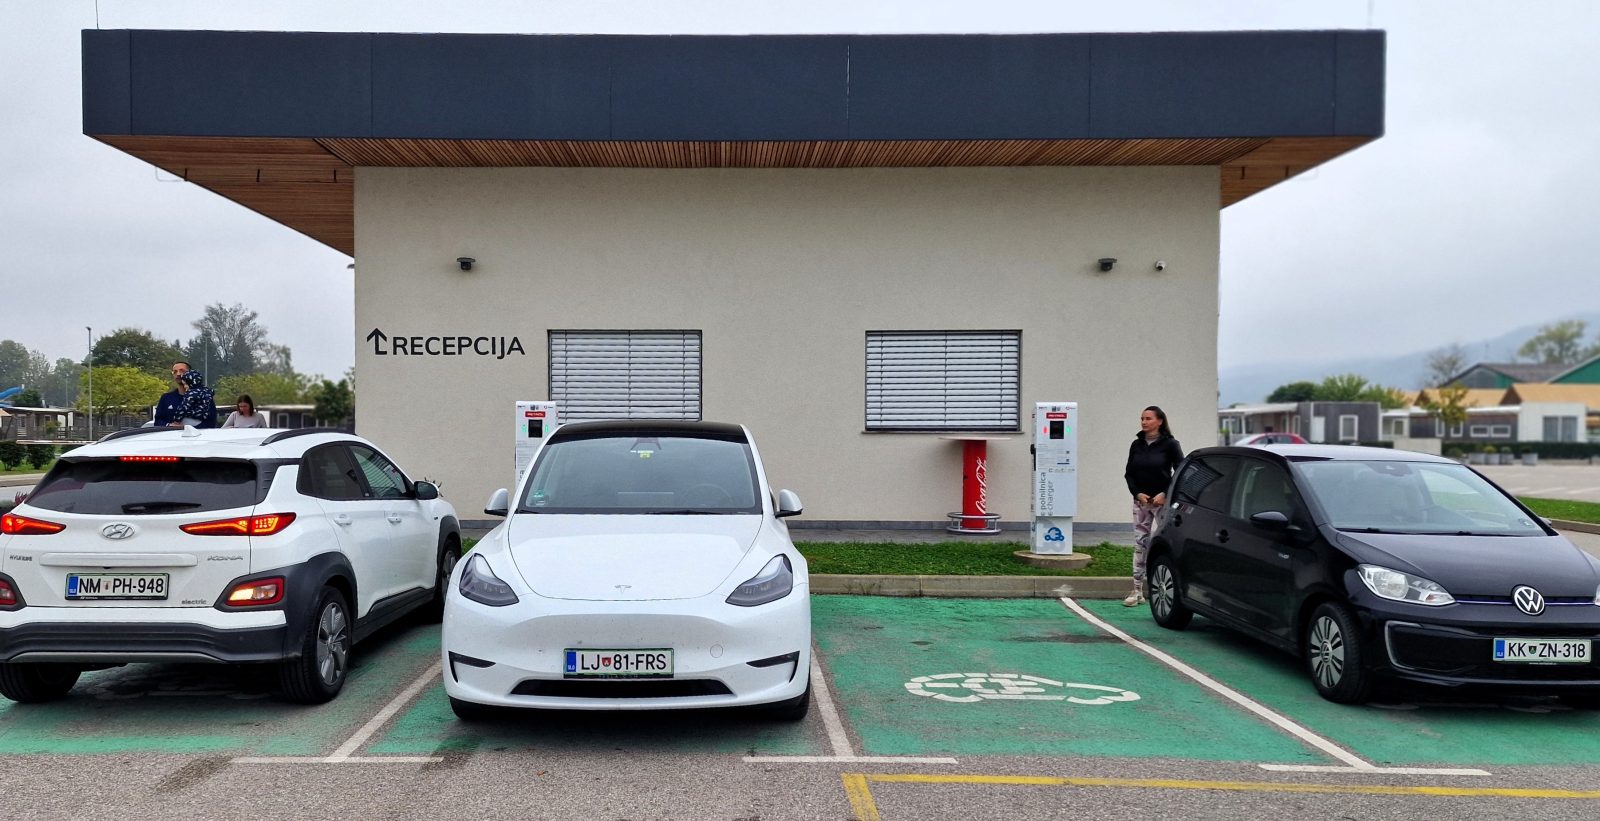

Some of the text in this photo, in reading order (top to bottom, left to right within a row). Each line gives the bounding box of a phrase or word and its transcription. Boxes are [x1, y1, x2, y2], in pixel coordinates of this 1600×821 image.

[392, 336, 526, 360] RECEPCIJA
[1039, 471, 1047, 510] polnilnica
[78, 577, 164, 594] NM PH-948
[1508, 642, 1586, 658] KK ZN-318
[581, 653, 667, 671] LJ 81-FRS
